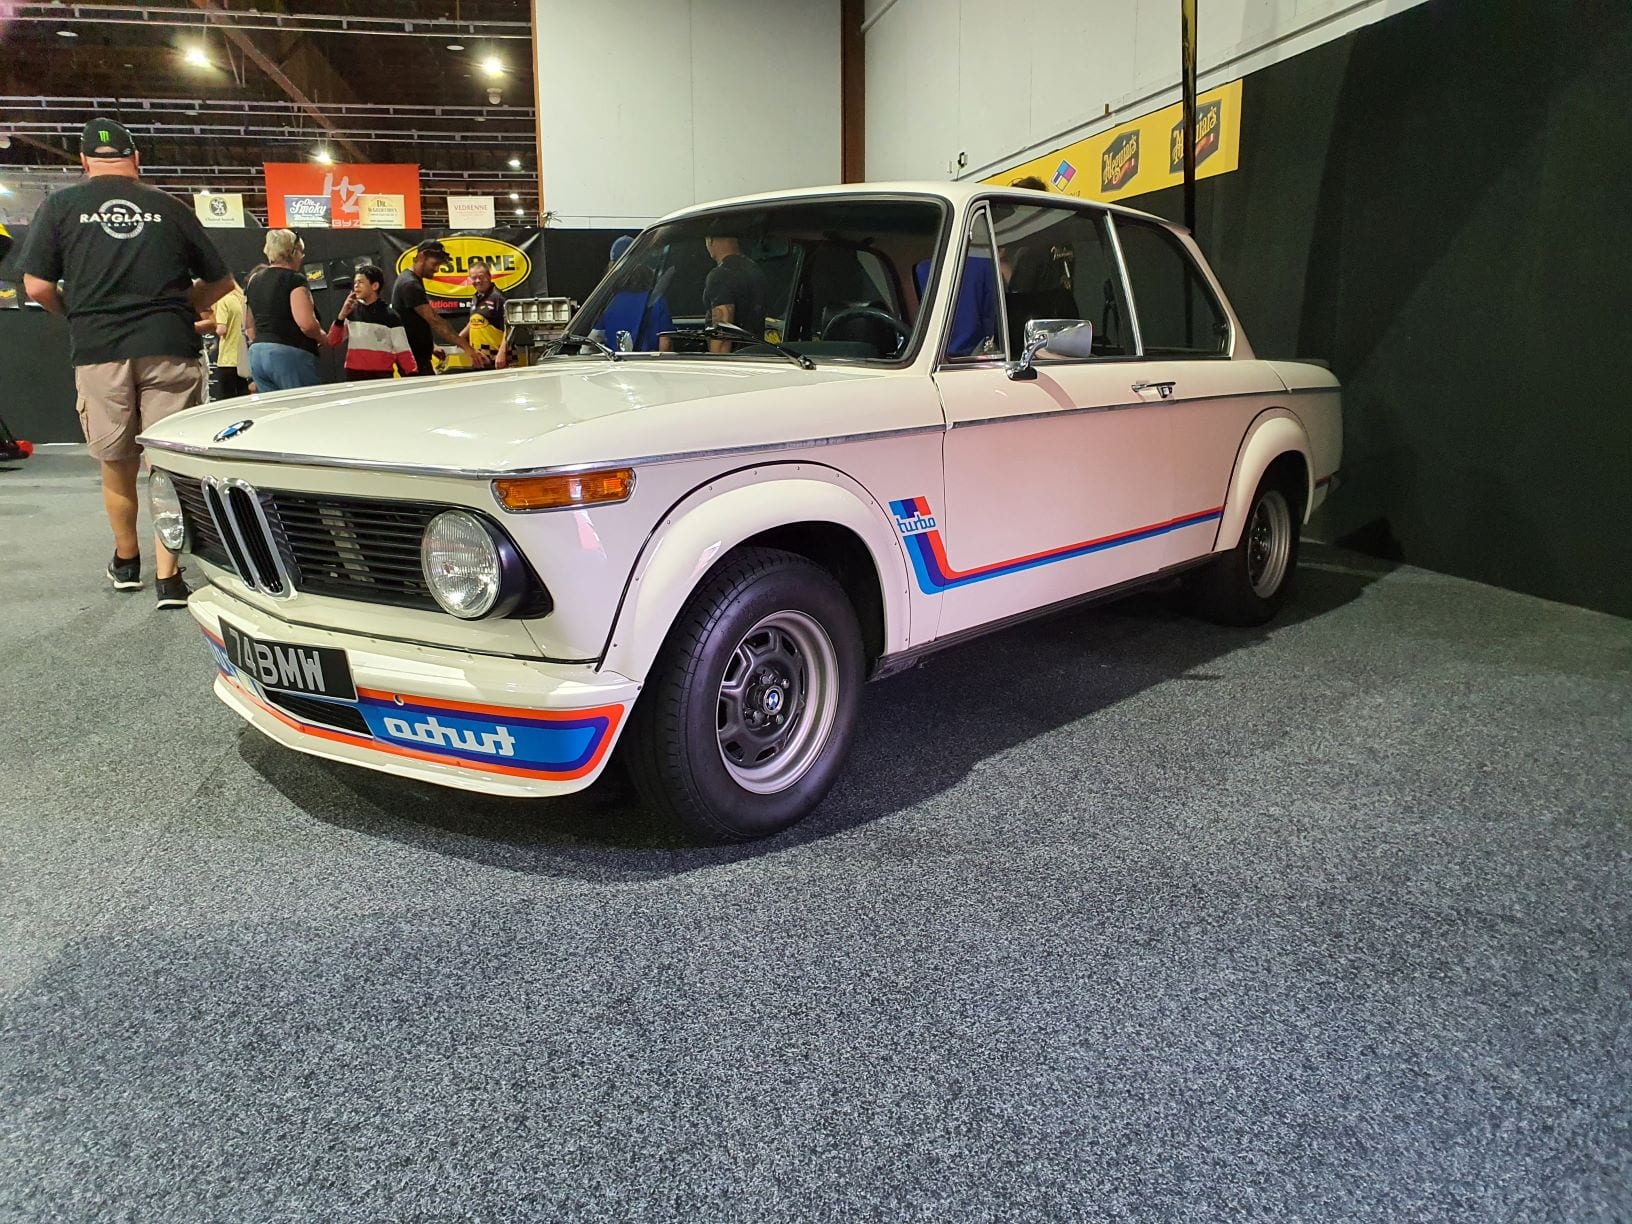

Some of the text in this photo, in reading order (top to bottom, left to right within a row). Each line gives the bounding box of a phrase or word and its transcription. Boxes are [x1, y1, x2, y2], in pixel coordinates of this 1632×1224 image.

[1103, 134, 1137, 185] Meguiar's
[79, 212, 162, 224] RAYGLASS
[289, 200, 327, 216] Smoky
[895, 512, 937, 534] turbo
[228, 626, 326, 693] 74BMW
